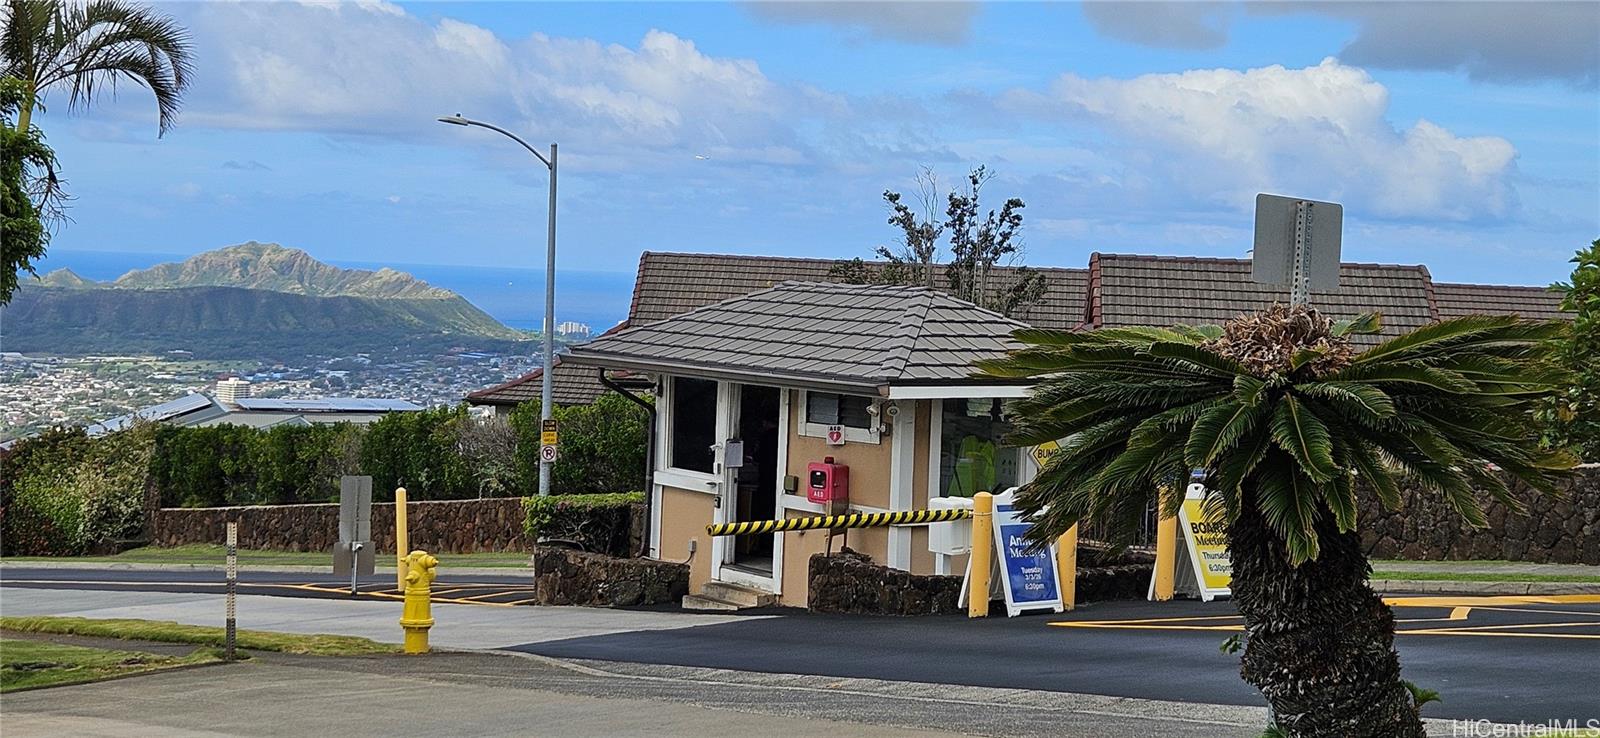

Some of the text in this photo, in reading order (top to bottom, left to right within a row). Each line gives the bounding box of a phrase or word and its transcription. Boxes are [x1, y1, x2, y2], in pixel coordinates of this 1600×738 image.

[1037, 448, 1059, 458] BUMP
[1202, 551, 1230, 560] Thursda
[1021, 566, 1042, 575] Tuesday
